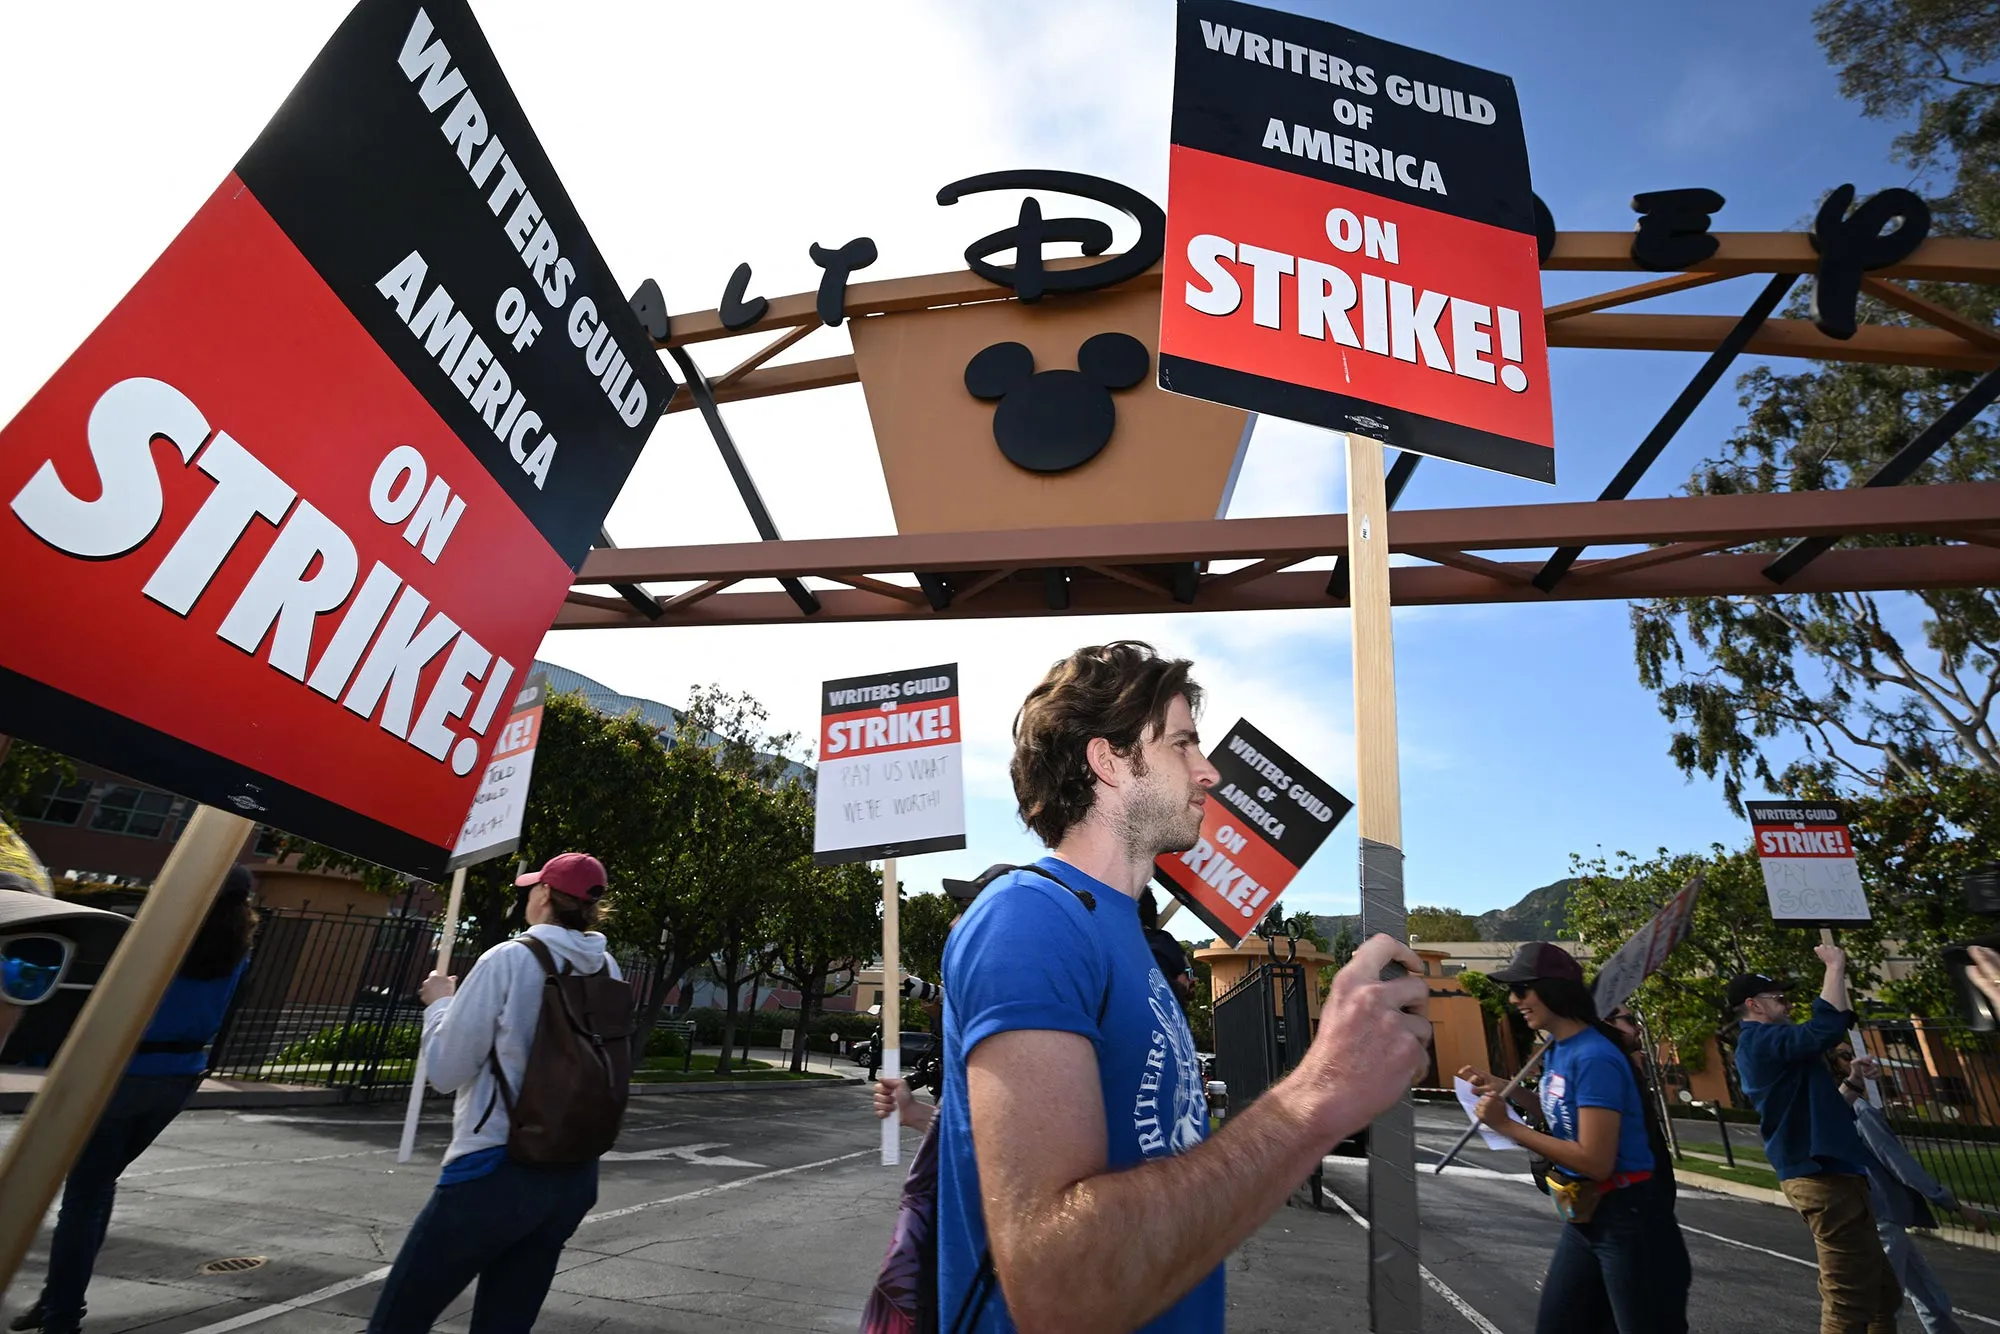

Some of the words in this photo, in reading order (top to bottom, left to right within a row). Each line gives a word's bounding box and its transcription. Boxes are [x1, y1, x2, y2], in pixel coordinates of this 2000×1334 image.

[1200, 19, 1377, 96] WRITERS
[1386, 75, 1496, 126] GUILD
[1333, 98, 1373, 130] OF
[1262, 119, 1447, 195] AMERICA
[398, 7, 575, 309] WRITERS
[568, 295, 648, 428] GUILD
[1325, 208, 1399, 265] ON
[496, 287, 543, 352] OF
[1185, 234, 1528, 394] STRIKE!
[375, 251, 560, 491] AMERICA
[369, 445, 467, 565] ON
[10, 377, 516, 777] STRIKE!
[828, 682, 900, 706] WRITERS
[903, 676, 950, 696] GUILD
[880, 701, 897, 712] ON
[827, 705, 952, 753] STRIKE!
[842, 763, 871, 787] PAY
[883, 760, 902, 782] US
[1228, 735, 1293, 791] WRITERS
[1288, 784, 1333, 823] GUILD
[1257, 786, 1278, 803] OF
[1215, 825, 1248, 855] ON
[1220, 783, 1286, 840] AMERICA
[1754, 808, 1804, 821] WRITERS
[1805, 809, 1837, 821] GUILD
[1793, 821, 1806, 830] ON
[1760, 831, 1846, 854] STRIKE!
[1176, 837, 1270, 918] RIKE!
[1768, 861, 1808, 886] PAY
[1825, 863, 1854, 885] UP
[1777, 888, 1867, 915] SCUM
[1133, 1029, 1167, 1160] RITERS
